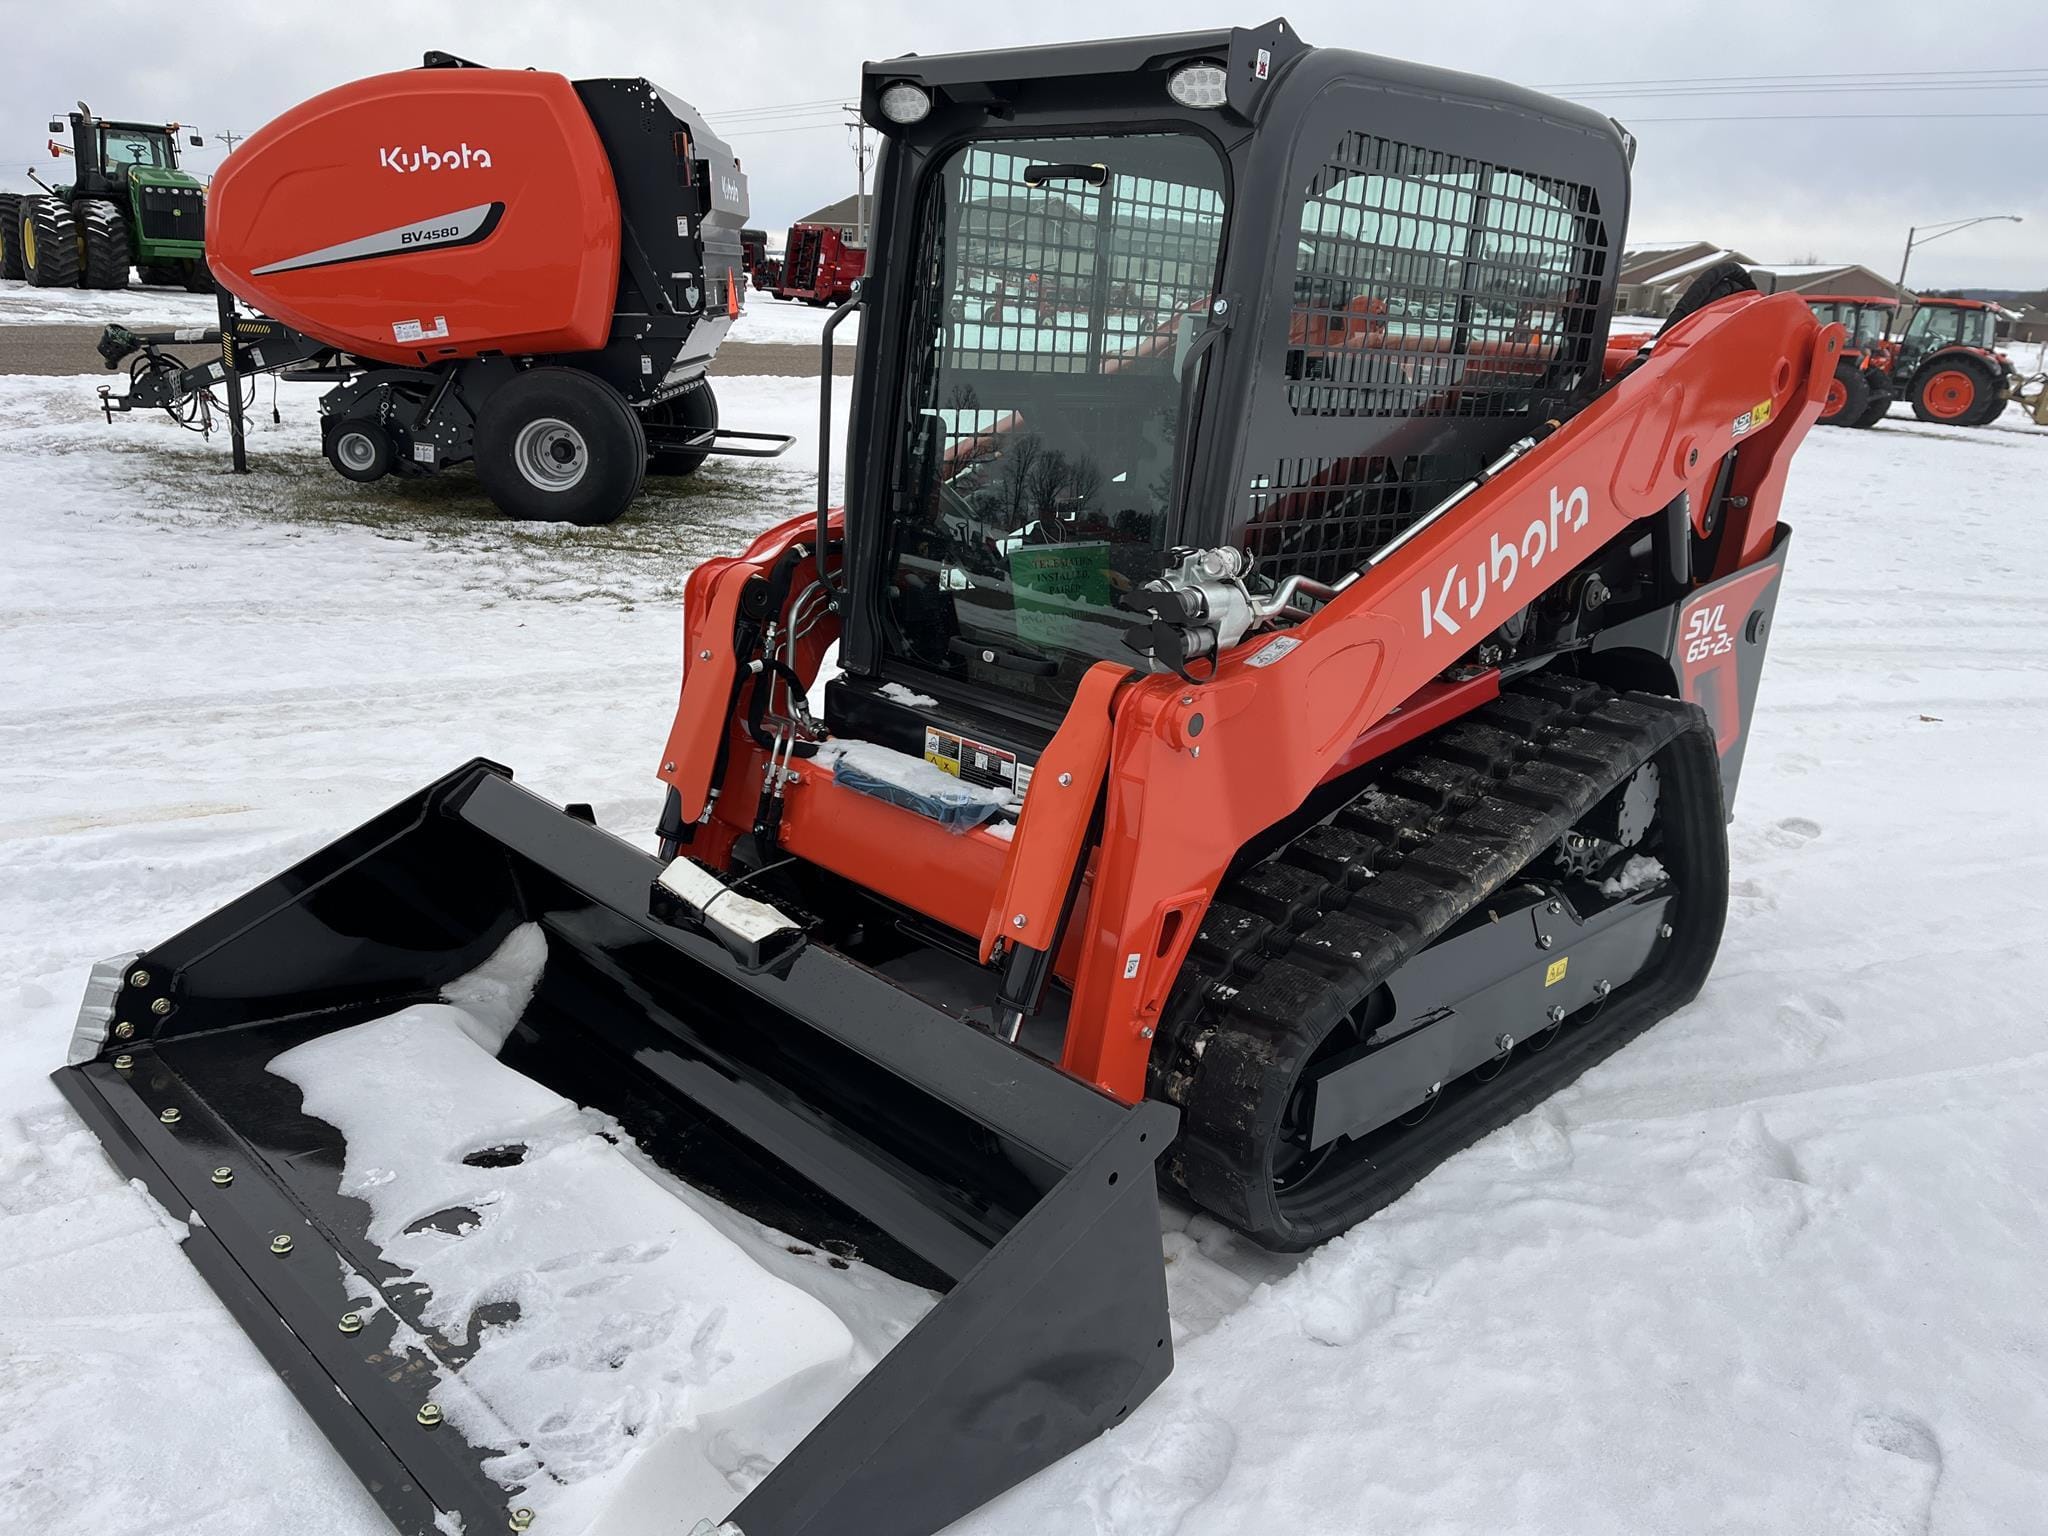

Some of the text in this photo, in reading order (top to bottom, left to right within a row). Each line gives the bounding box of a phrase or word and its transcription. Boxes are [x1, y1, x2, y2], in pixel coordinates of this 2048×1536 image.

[380, 143, 492, 173] Kubota
[721, 175, 739, 203] Kubota
[401, 226, 459, 244] BV4580
[1421, 485, 1589, 640] Kubota
[1049, 583, 1082, 595] PAIRED
[1684, 604, 1728, 641] SVL
